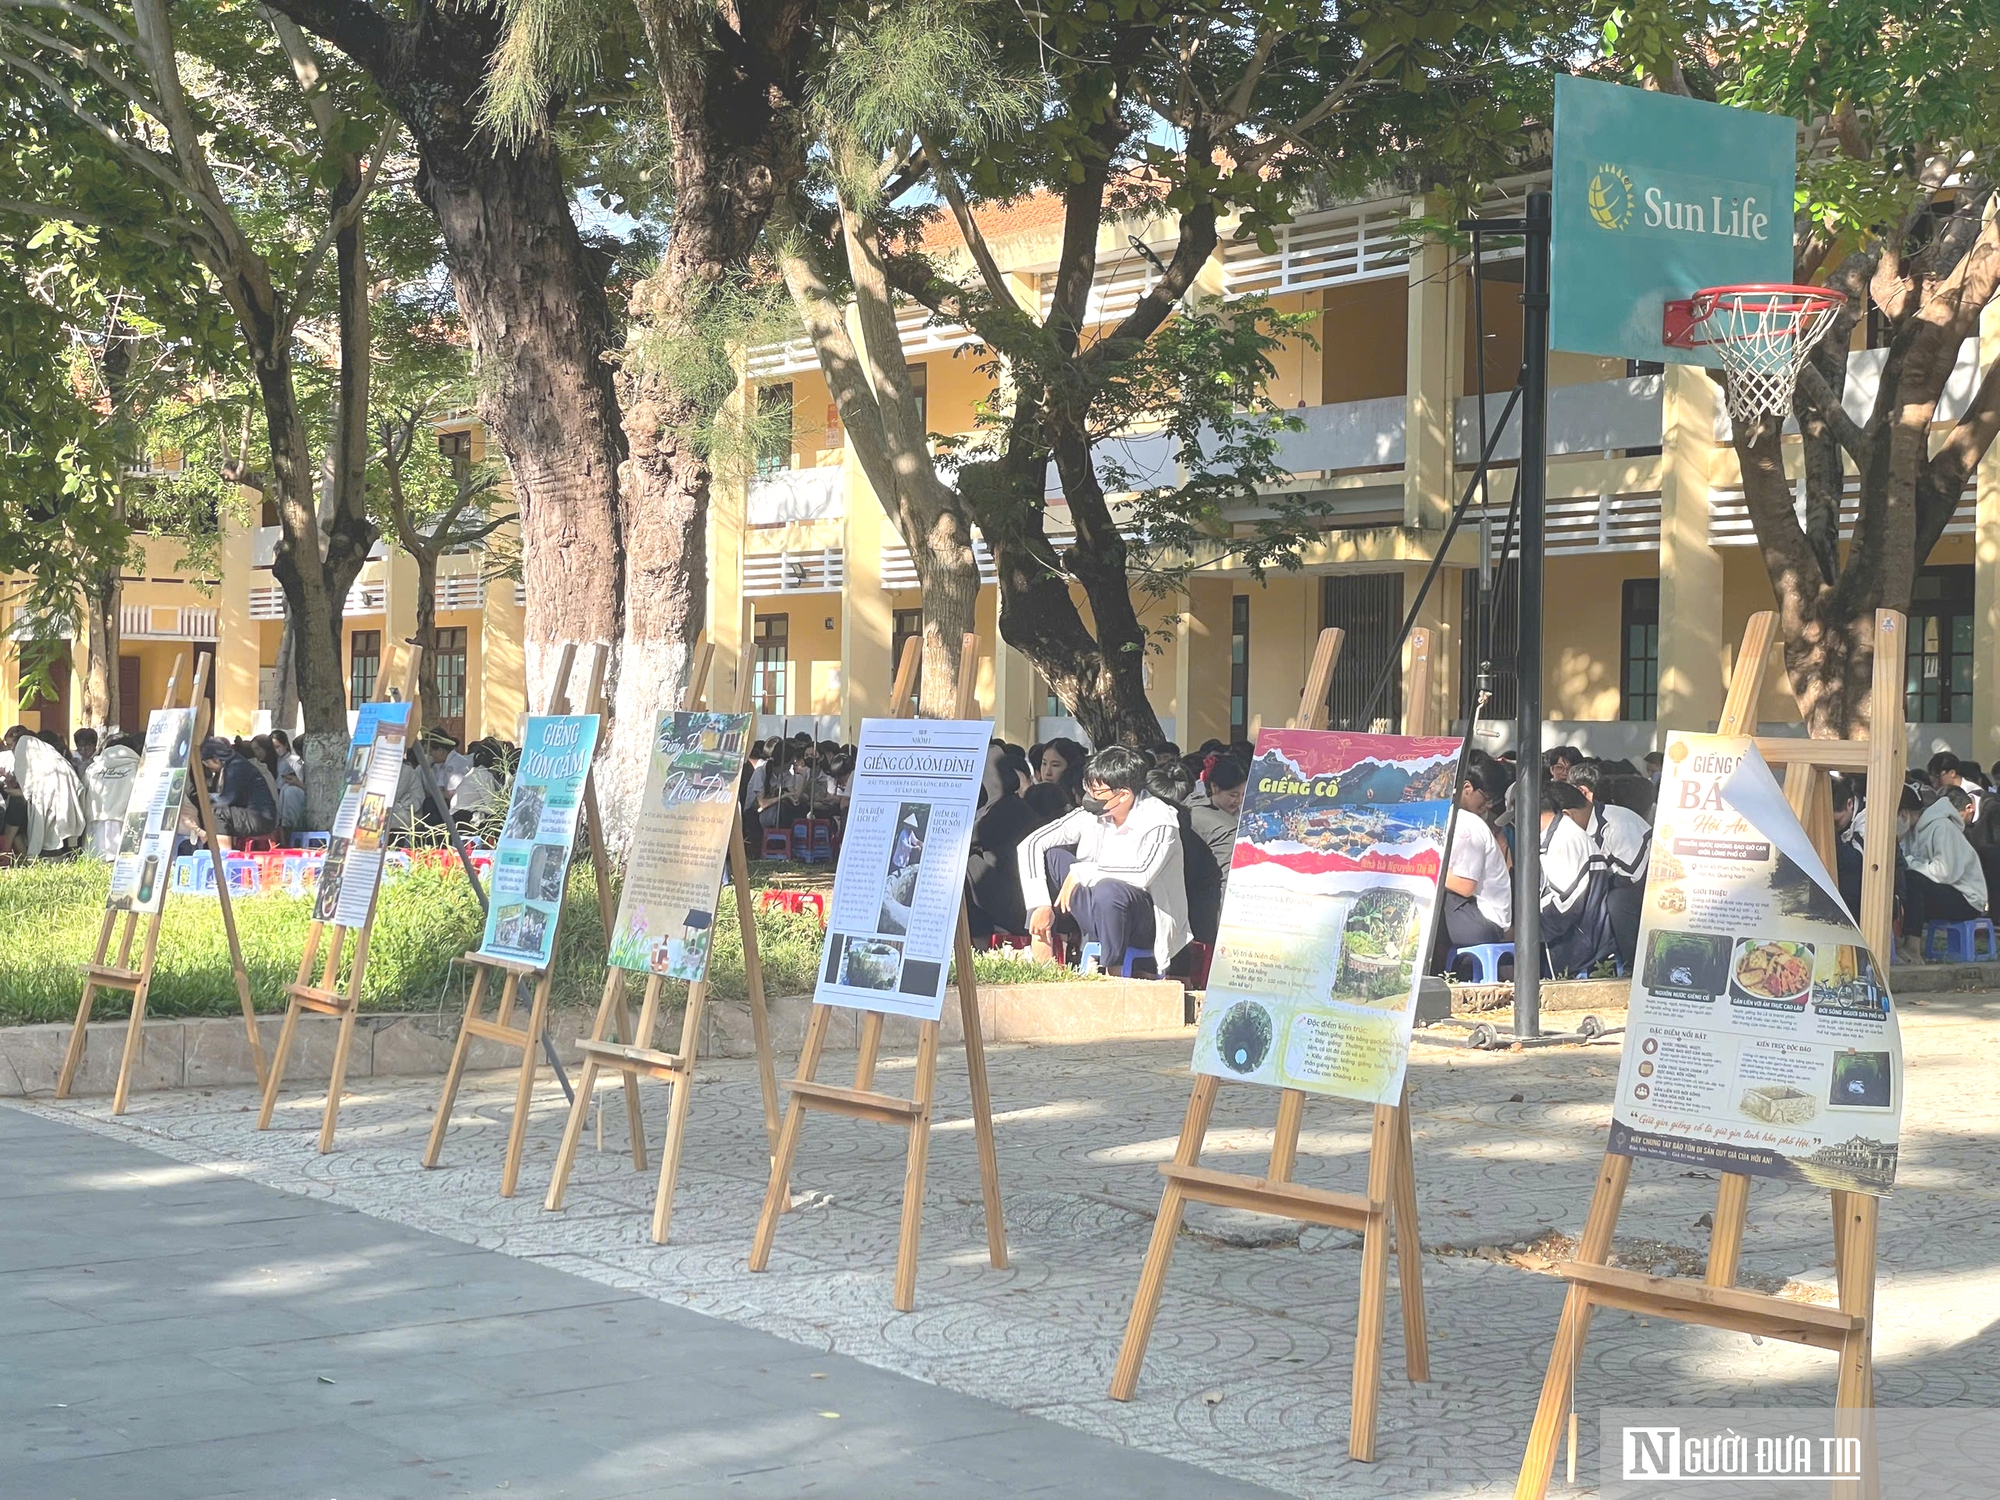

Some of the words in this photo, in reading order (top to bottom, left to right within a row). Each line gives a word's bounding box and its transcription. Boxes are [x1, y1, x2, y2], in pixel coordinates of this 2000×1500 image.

[1644, 187, 1706, 233] Sun
[1711, 196, 1768, 241] Life
[543, 717, 582, 747] GIẾNG
[523, 746, 554, 780] XÓM
[863, 753, 898, 771] GIẾNG
[915, 755, 943, 772] XÓM
[944, 756, 975, 773] ĐÌNH
[1693, 751, 1732, 775] GIẾNG
[1259, 774, 1311, 796] GIẾNG
[1315, 777, 1342, 798] CỔ
[1677, 775, 1725, 812] BÁ
[1693, 814, 1723, 834] Hội
[1723, 817, 1749, 835] An
